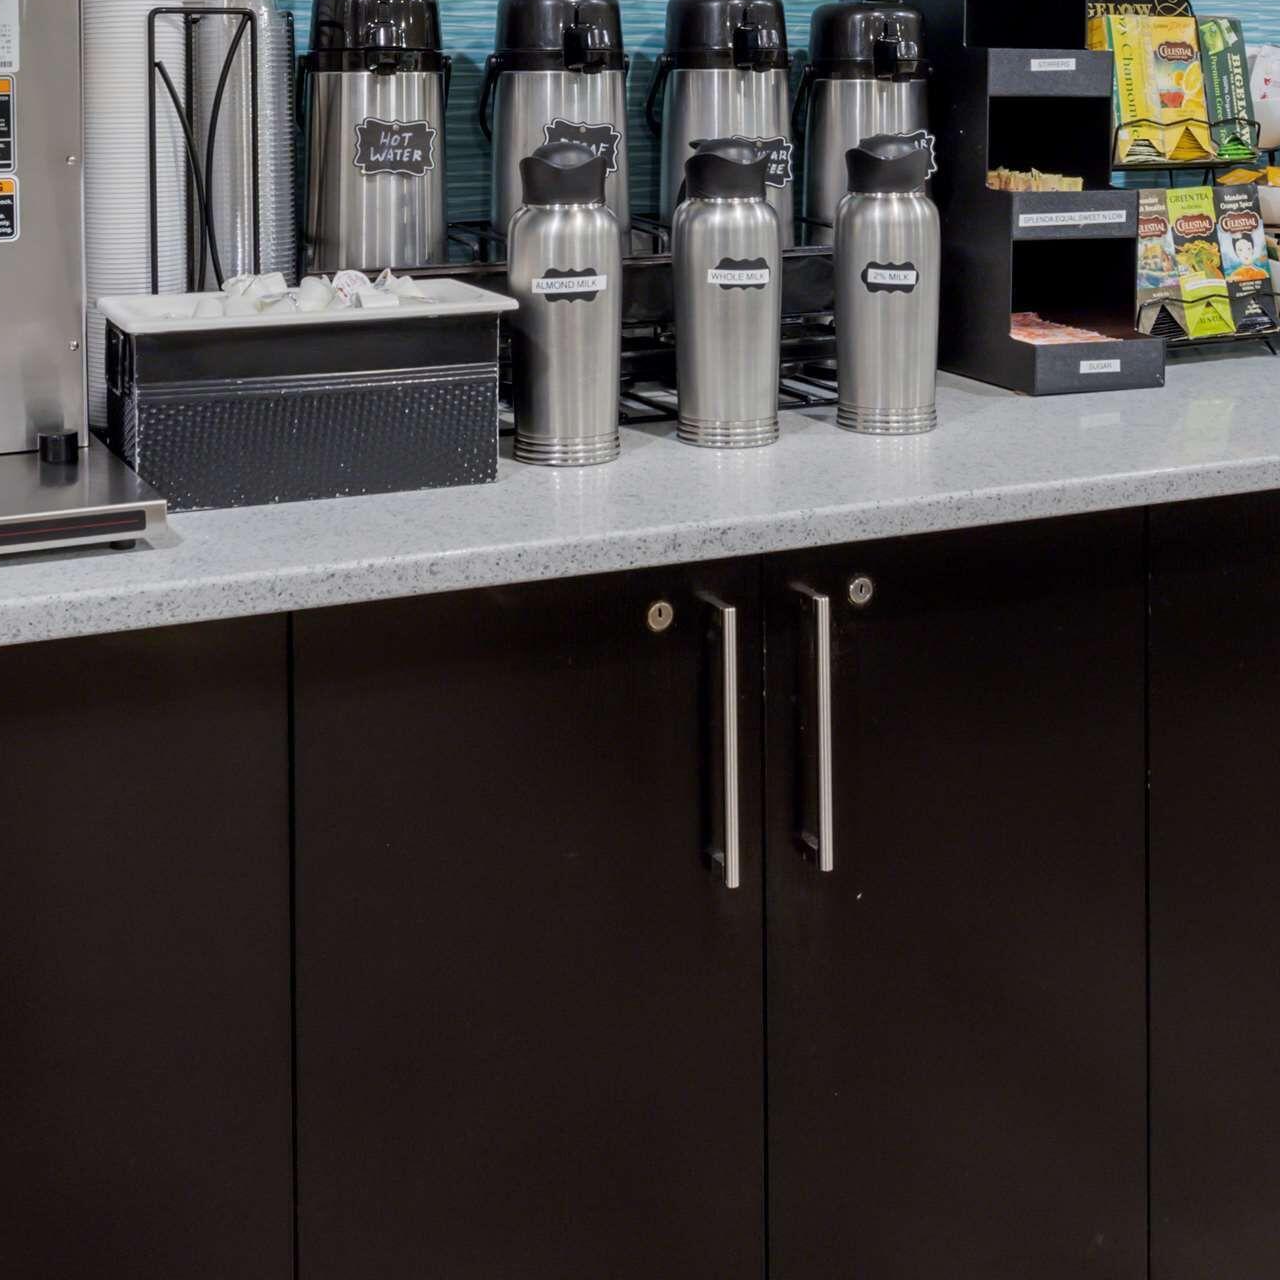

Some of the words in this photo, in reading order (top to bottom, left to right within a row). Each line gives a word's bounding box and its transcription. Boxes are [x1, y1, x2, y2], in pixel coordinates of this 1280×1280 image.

[1087, 3, 1153, 17] GELOW
[1158, 45, 1192, 57] CELESTIAL
[380, 131, 413, 146] HOT
[370, 147, 422, 161] WATER
[1170, 194, 1193, 203] GREEN
[1194, 193, 1208, 201] TEA
[1177, 222, 1211, 231] CELESTIAL
[1222, 219, 1257, 232] CELESTIAL
[711, 273, 744, 281] WHOLE
[745, 273, 766, 281] MILK
[888, 272, 910, 281] MILK
[535, 281, 576, 290] ALMOND
[576, 279, 598, 288] MILK
